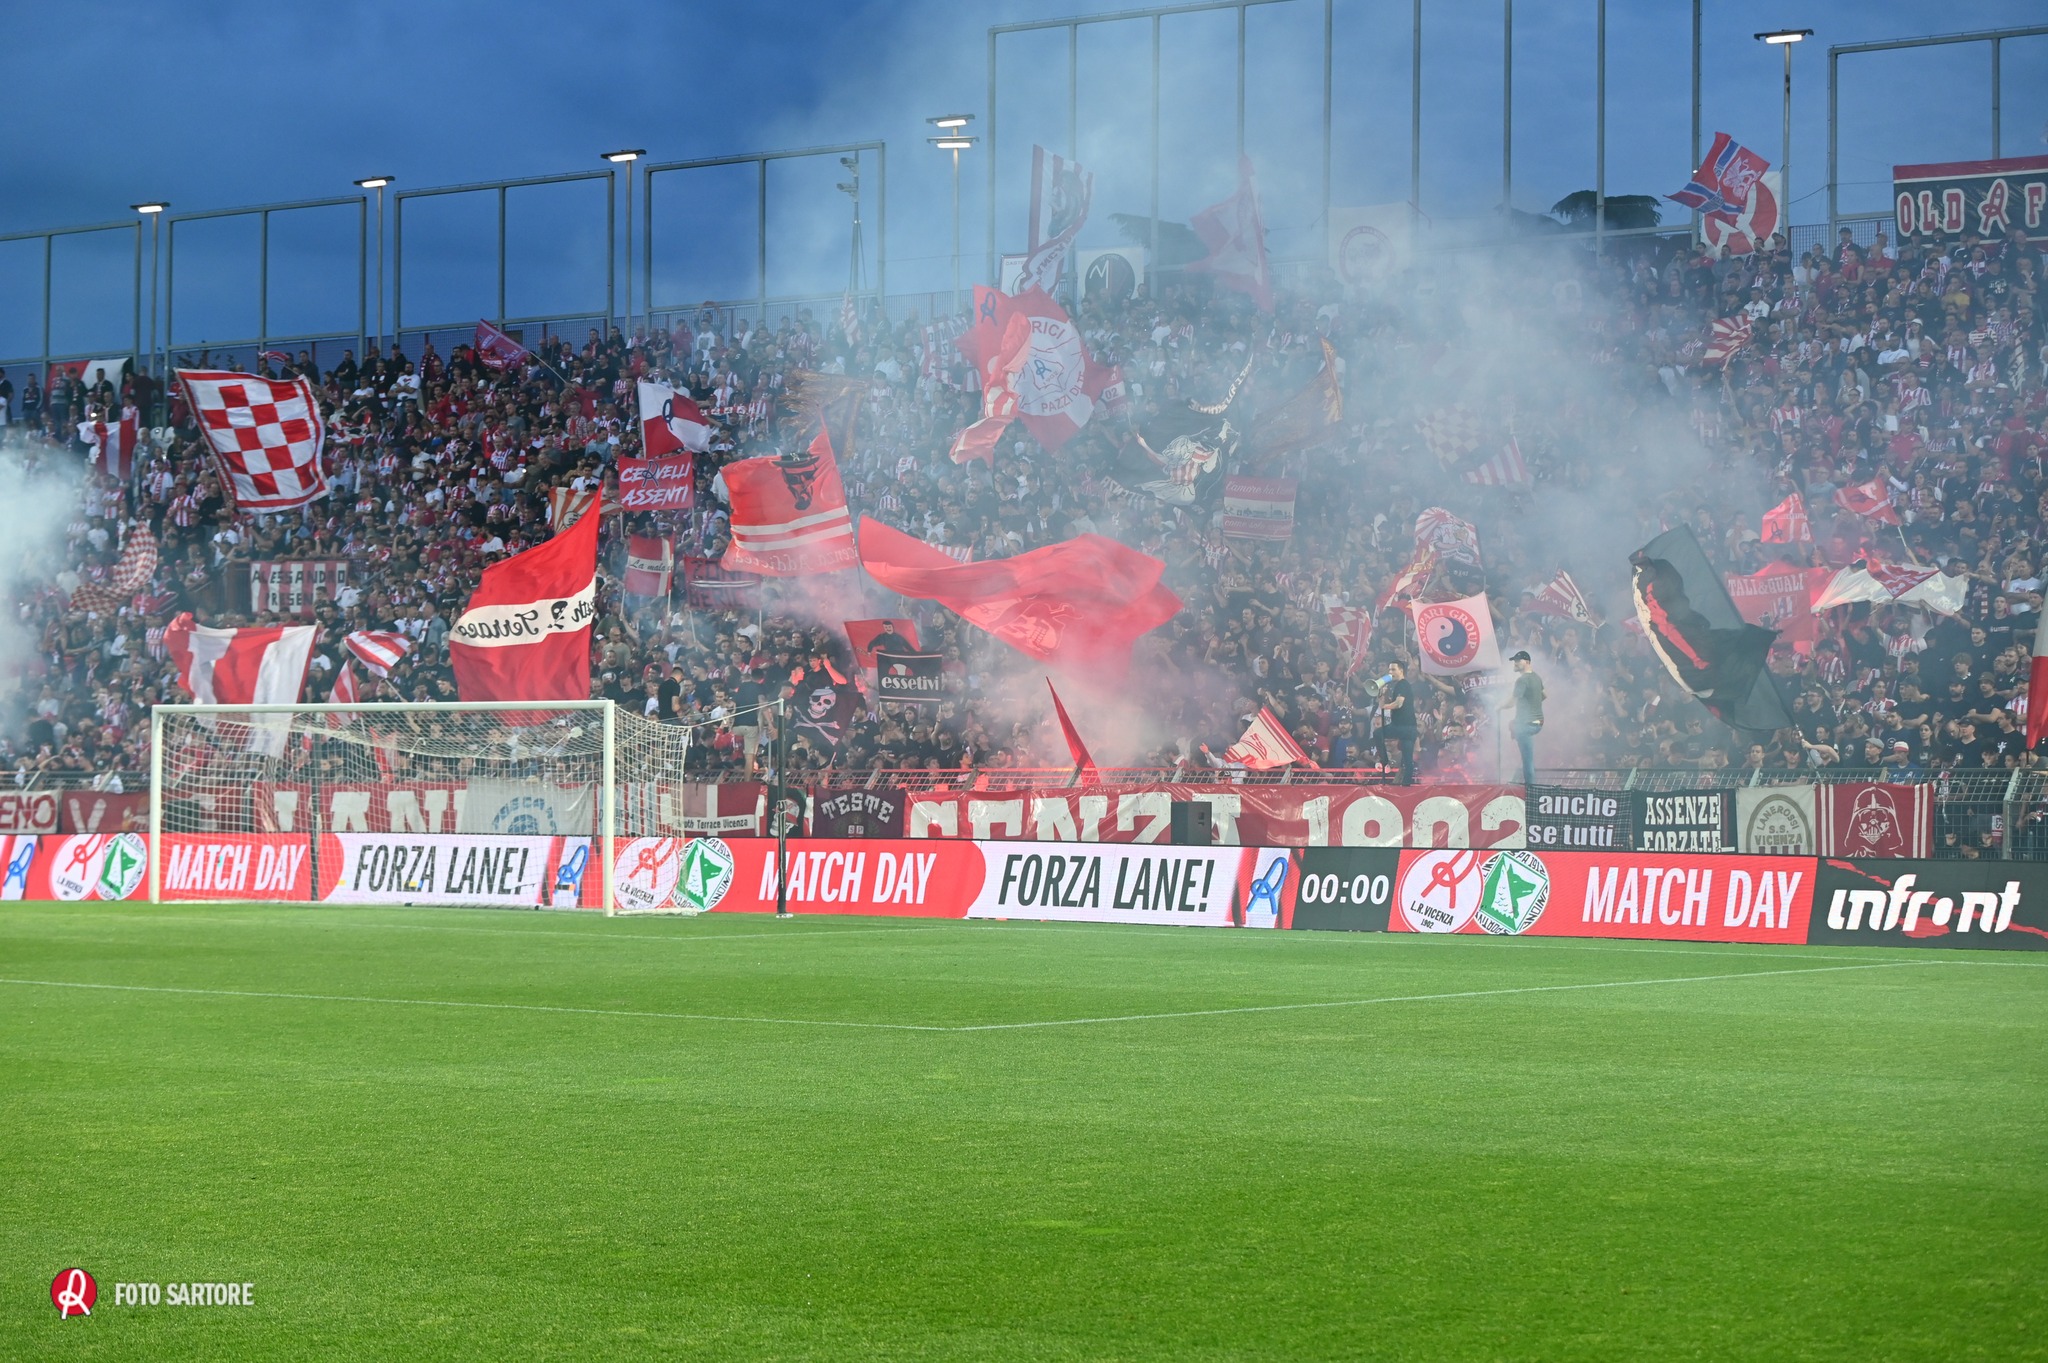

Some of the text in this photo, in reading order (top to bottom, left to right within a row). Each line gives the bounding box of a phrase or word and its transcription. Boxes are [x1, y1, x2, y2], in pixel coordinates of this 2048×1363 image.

[1897, 188, 1965, 237] OLD
[1031, 320, 1066, 340] RICI
[1041, 394, 1071, 413] PAZZI
[621, 485, 689, 507] ASSENTI
[1449, 609, 1478, 650] GROUP
[881, 676, 939, 690] essetivi
[821, 792, 895, 823] TESTE
[1538, 794, 1617, 817] anche
[1645, 796, 1722, 825] ASSENZE
[1756, 805, 1800, 831] LANEROSSI
[697, 819, 721, 830] Terrace
[722, 817, 748, 829] Vicenza
[1528, 825, 1557, 843] se
[1643, 830, 1722, 852] FORZATE
[1754, 834, 1803, 846] VICENZA
[165, 844, 251, 891] MATCH
[254, 844, 306, 891] DAY
[354, 844, 529, 895] FORZA LANE!
[759, 851, 937, 905] MATCH DAY
[998, 854, 1215, 912] FORZA LANE!
[1302, 873, 1389, 904] 00:00
[1582, 866, 1803, 929] MATCH DAY
[1827, 874, 2021, 933] infront
[1420, 918, 1434, 929] 1902
